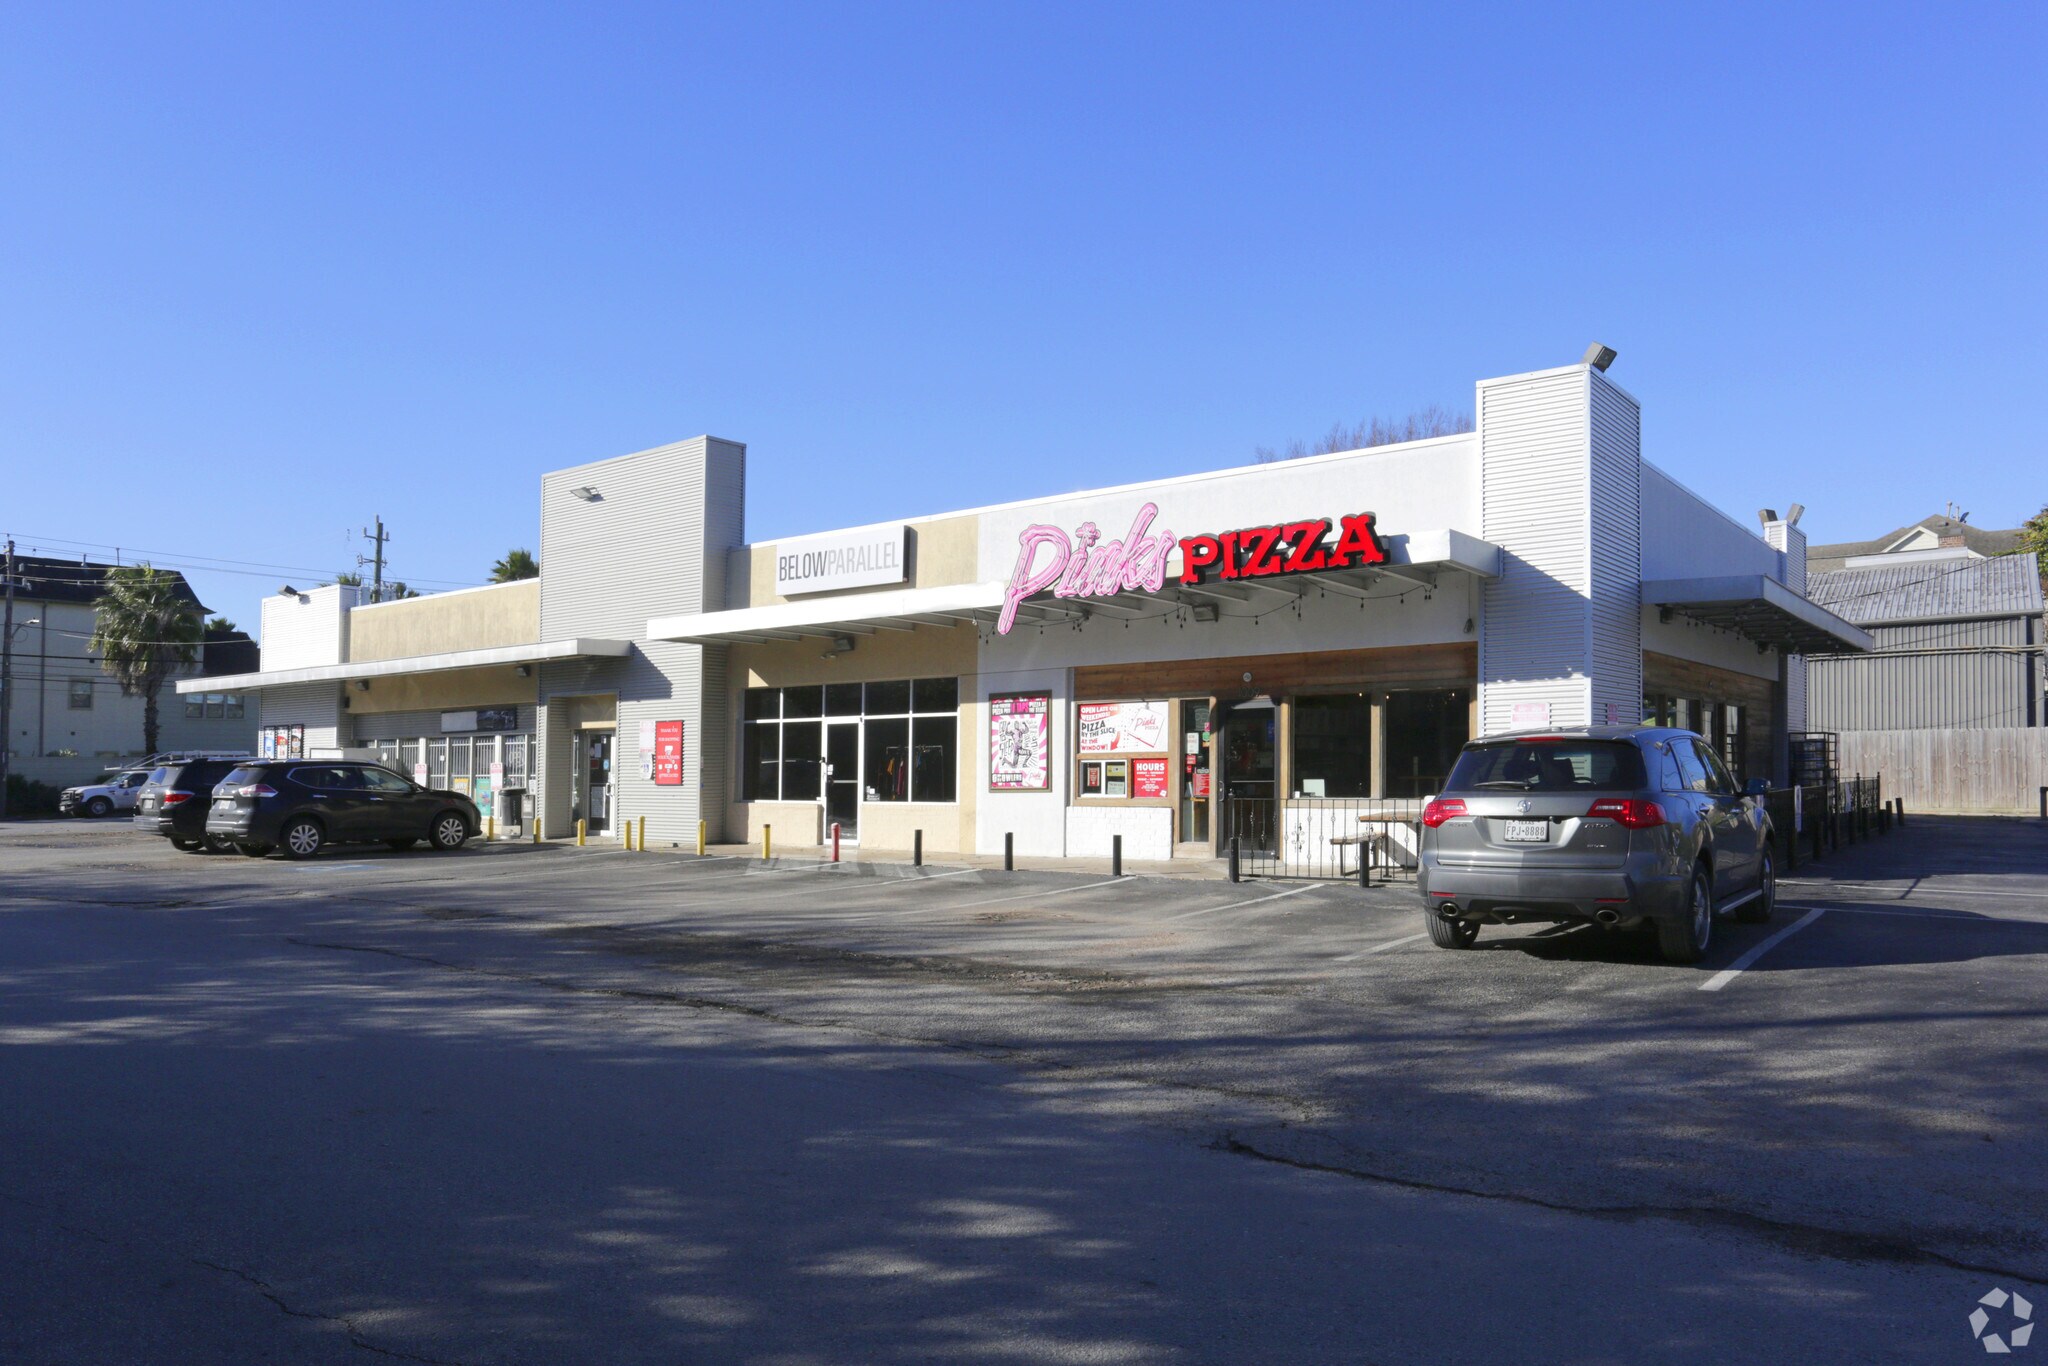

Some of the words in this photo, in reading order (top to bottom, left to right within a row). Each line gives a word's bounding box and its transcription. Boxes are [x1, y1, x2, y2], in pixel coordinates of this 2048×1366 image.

[1179, 514, 1388, 587] PIZZA
[1081, 720, 1106, 732] PIZZA
[1089, 730, 1099, 738] THE
[1100, 727, 1116, 735] SLICE
[1136, 762, 1165, 771] HOURS
